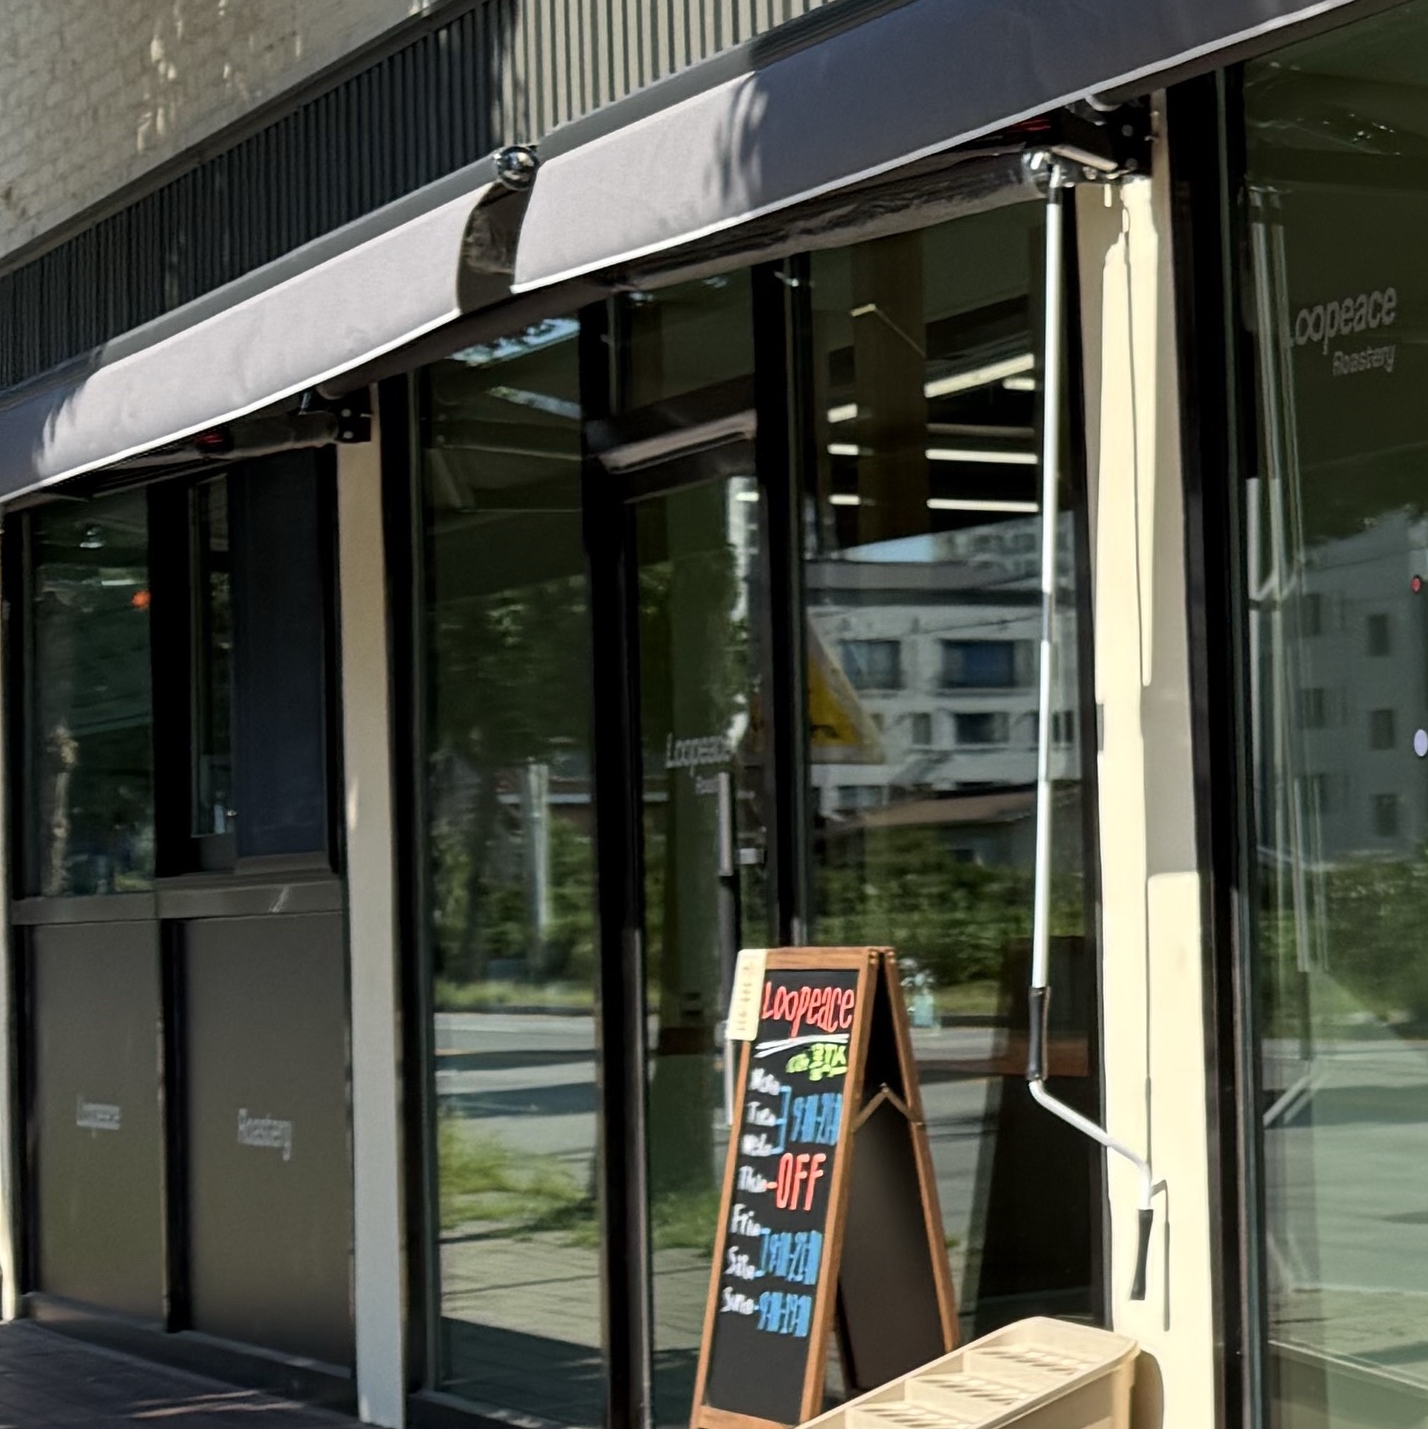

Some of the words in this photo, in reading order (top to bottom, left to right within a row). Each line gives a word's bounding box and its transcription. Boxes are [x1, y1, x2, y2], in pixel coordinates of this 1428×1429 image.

[1290, 287, 1397, 355] oopeace
[761, 981, 855, 1038] Loopeace
[777, 1152, 826, 1211] OFF
